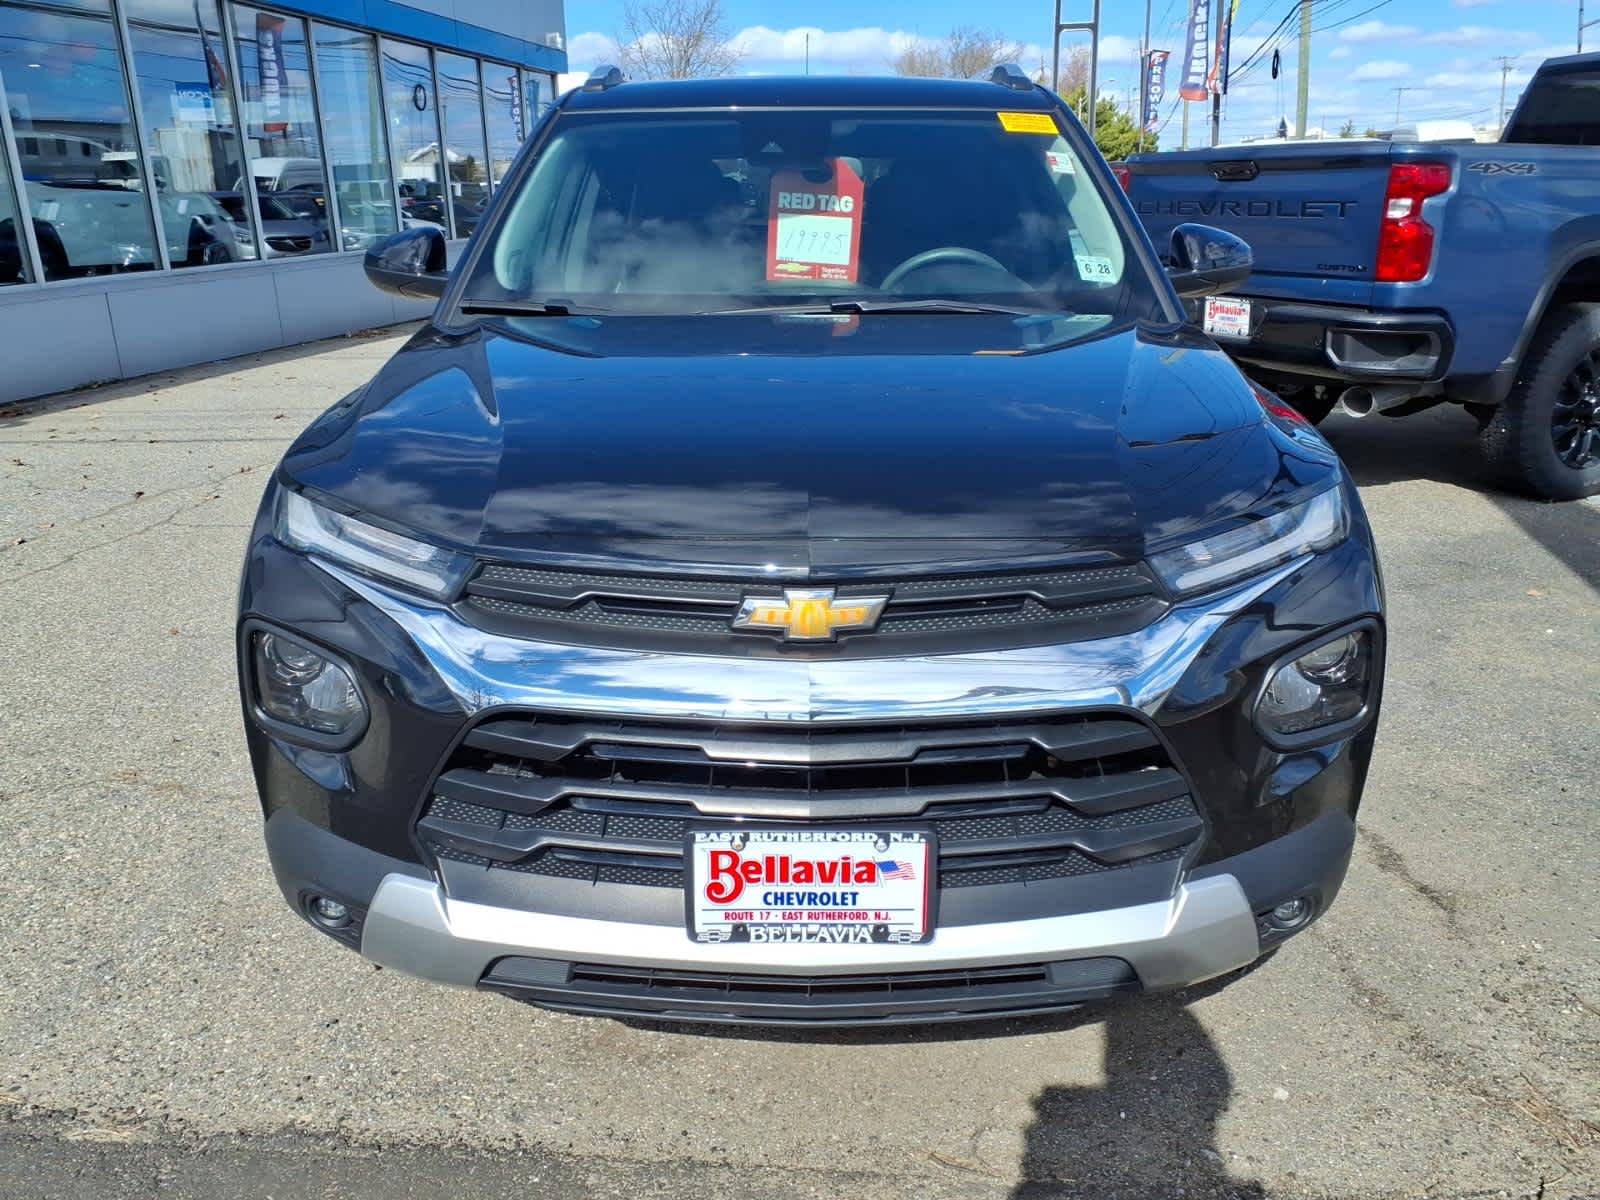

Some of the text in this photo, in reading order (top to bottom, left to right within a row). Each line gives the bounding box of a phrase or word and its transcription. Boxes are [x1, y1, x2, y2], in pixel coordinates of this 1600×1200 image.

[778, 191, 855, 213] RED TAG
[1136, 199, 1358, 219] CHEVROLET
[1085, 263, 1111, 275] 6 28
[694, 832, 744, 842] EAST
[706, 850, 876, 905] Bellavia
[763, 891, 859, 906] CHEVROLET
[724, 911, 892, 921] ROUTE 17 EAST RUTHERFORD, N.J.
[749, 924, 873, 943] BELLAVIA
